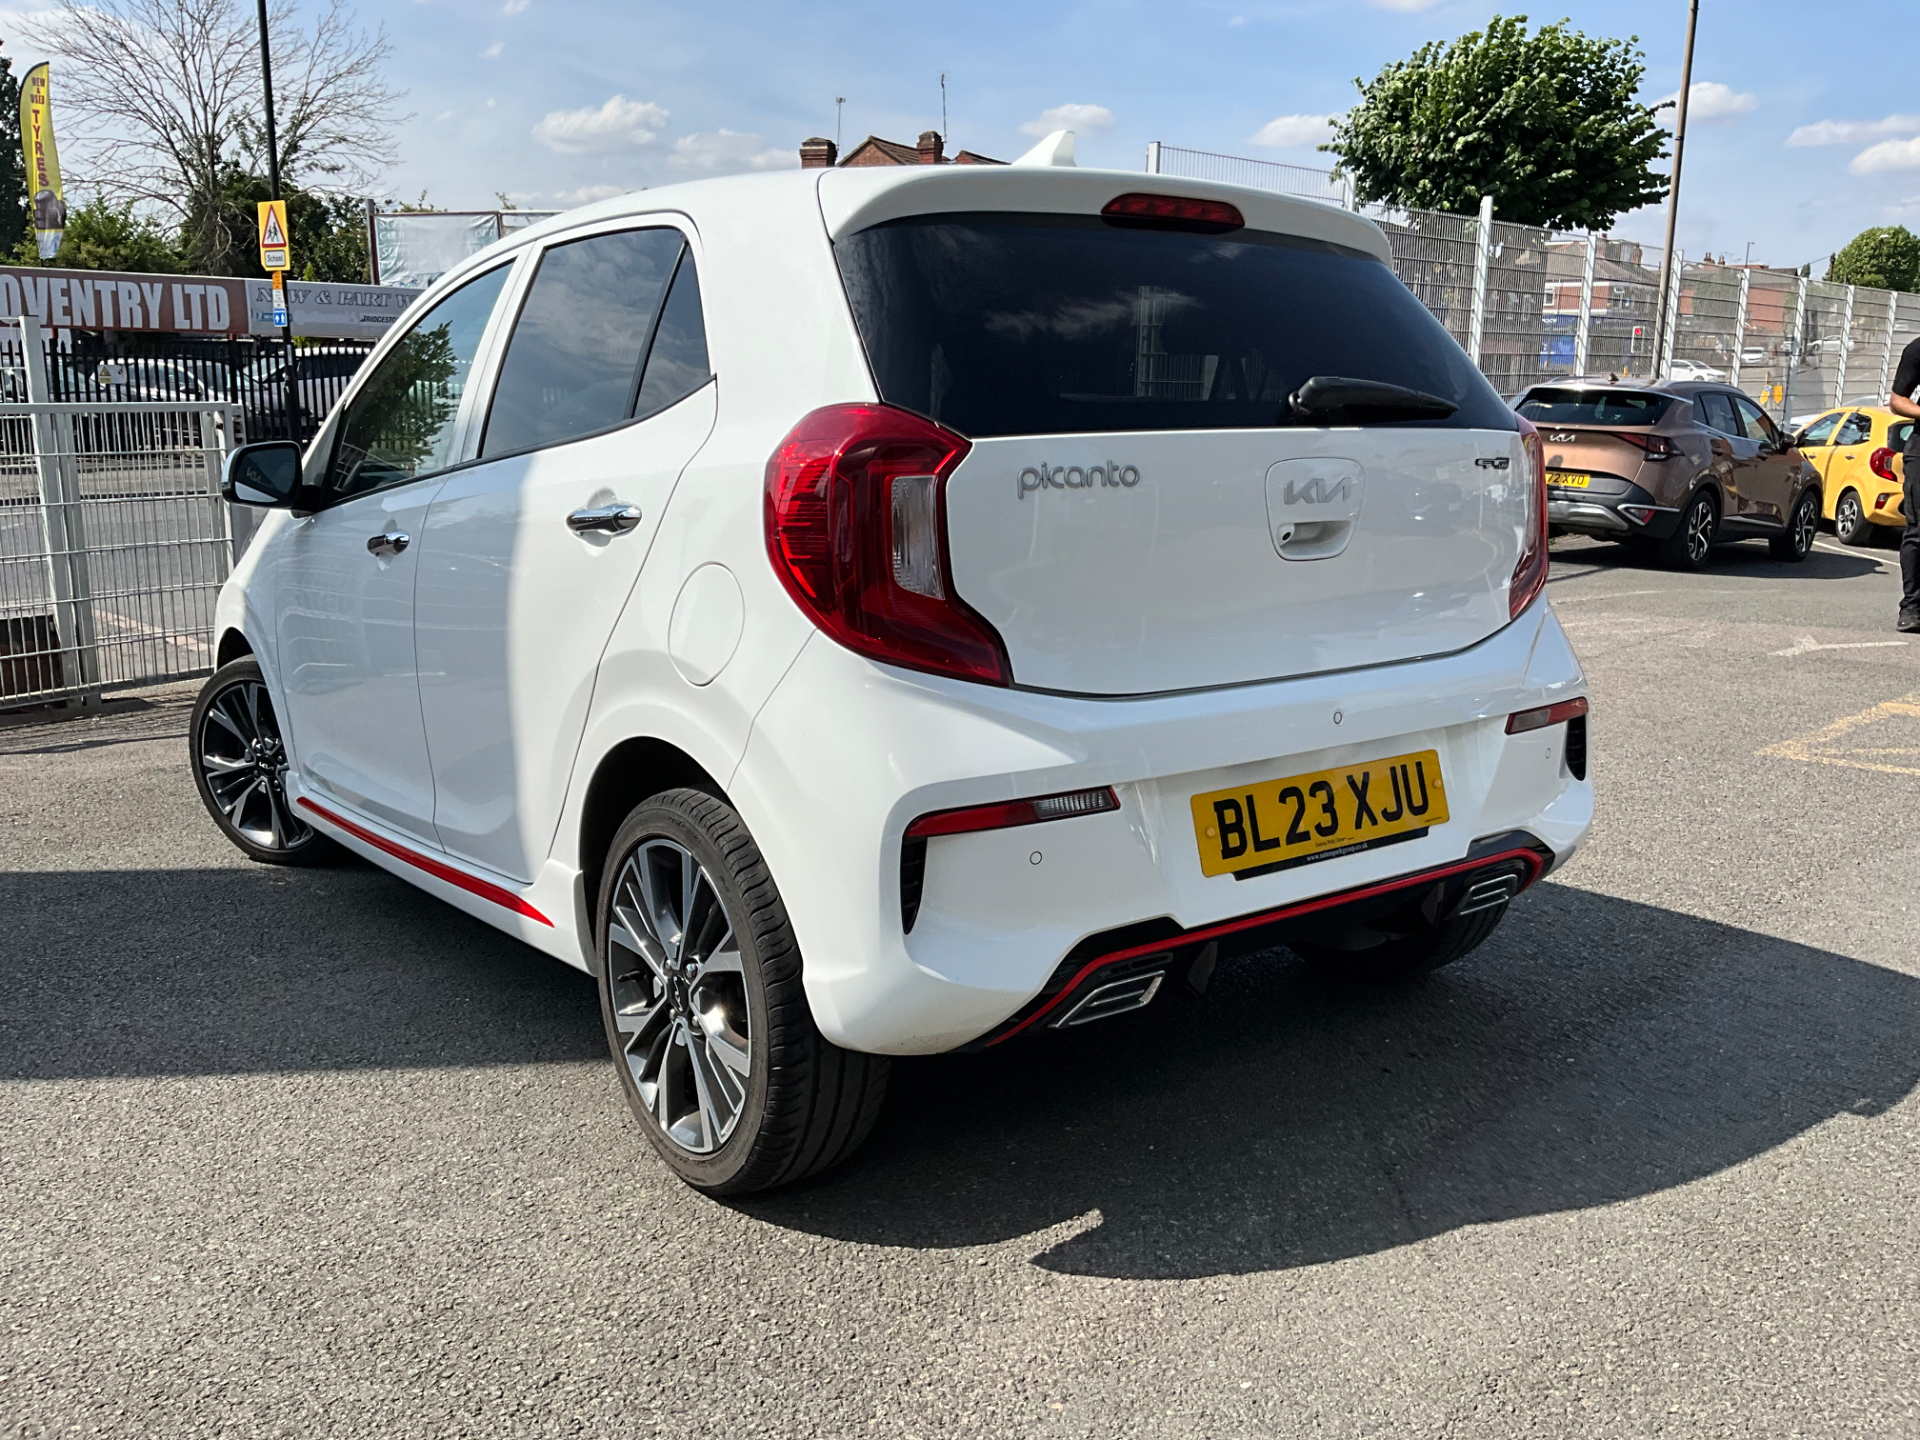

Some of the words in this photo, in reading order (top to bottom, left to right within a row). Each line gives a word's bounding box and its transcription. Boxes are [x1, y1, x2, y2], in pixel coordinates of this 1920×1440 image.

[32, 77, 45, 88] NEW
[30, 93, 45, 105] USED
[32, 109, 49, 187] TYRES
[267, 254, 284, 263] School
[0, 273, 163, 329] OVENTRY
[172, 283, 231, 331] LTD
[256, 287, 312, 304] NW
[315, 290, 332, 305] &
[337, 291, 391, 308] PART
[360, 315, 399, 323] BRIDGESTO
[1016, 460, 1141, 500] picanto
[1547, 473, 1560, 483] 72
[1283, 477, 1352, 506] KIA
[1213, 780, 1339, 860] BL23
[1346, 761, 1429, 830] XJU
